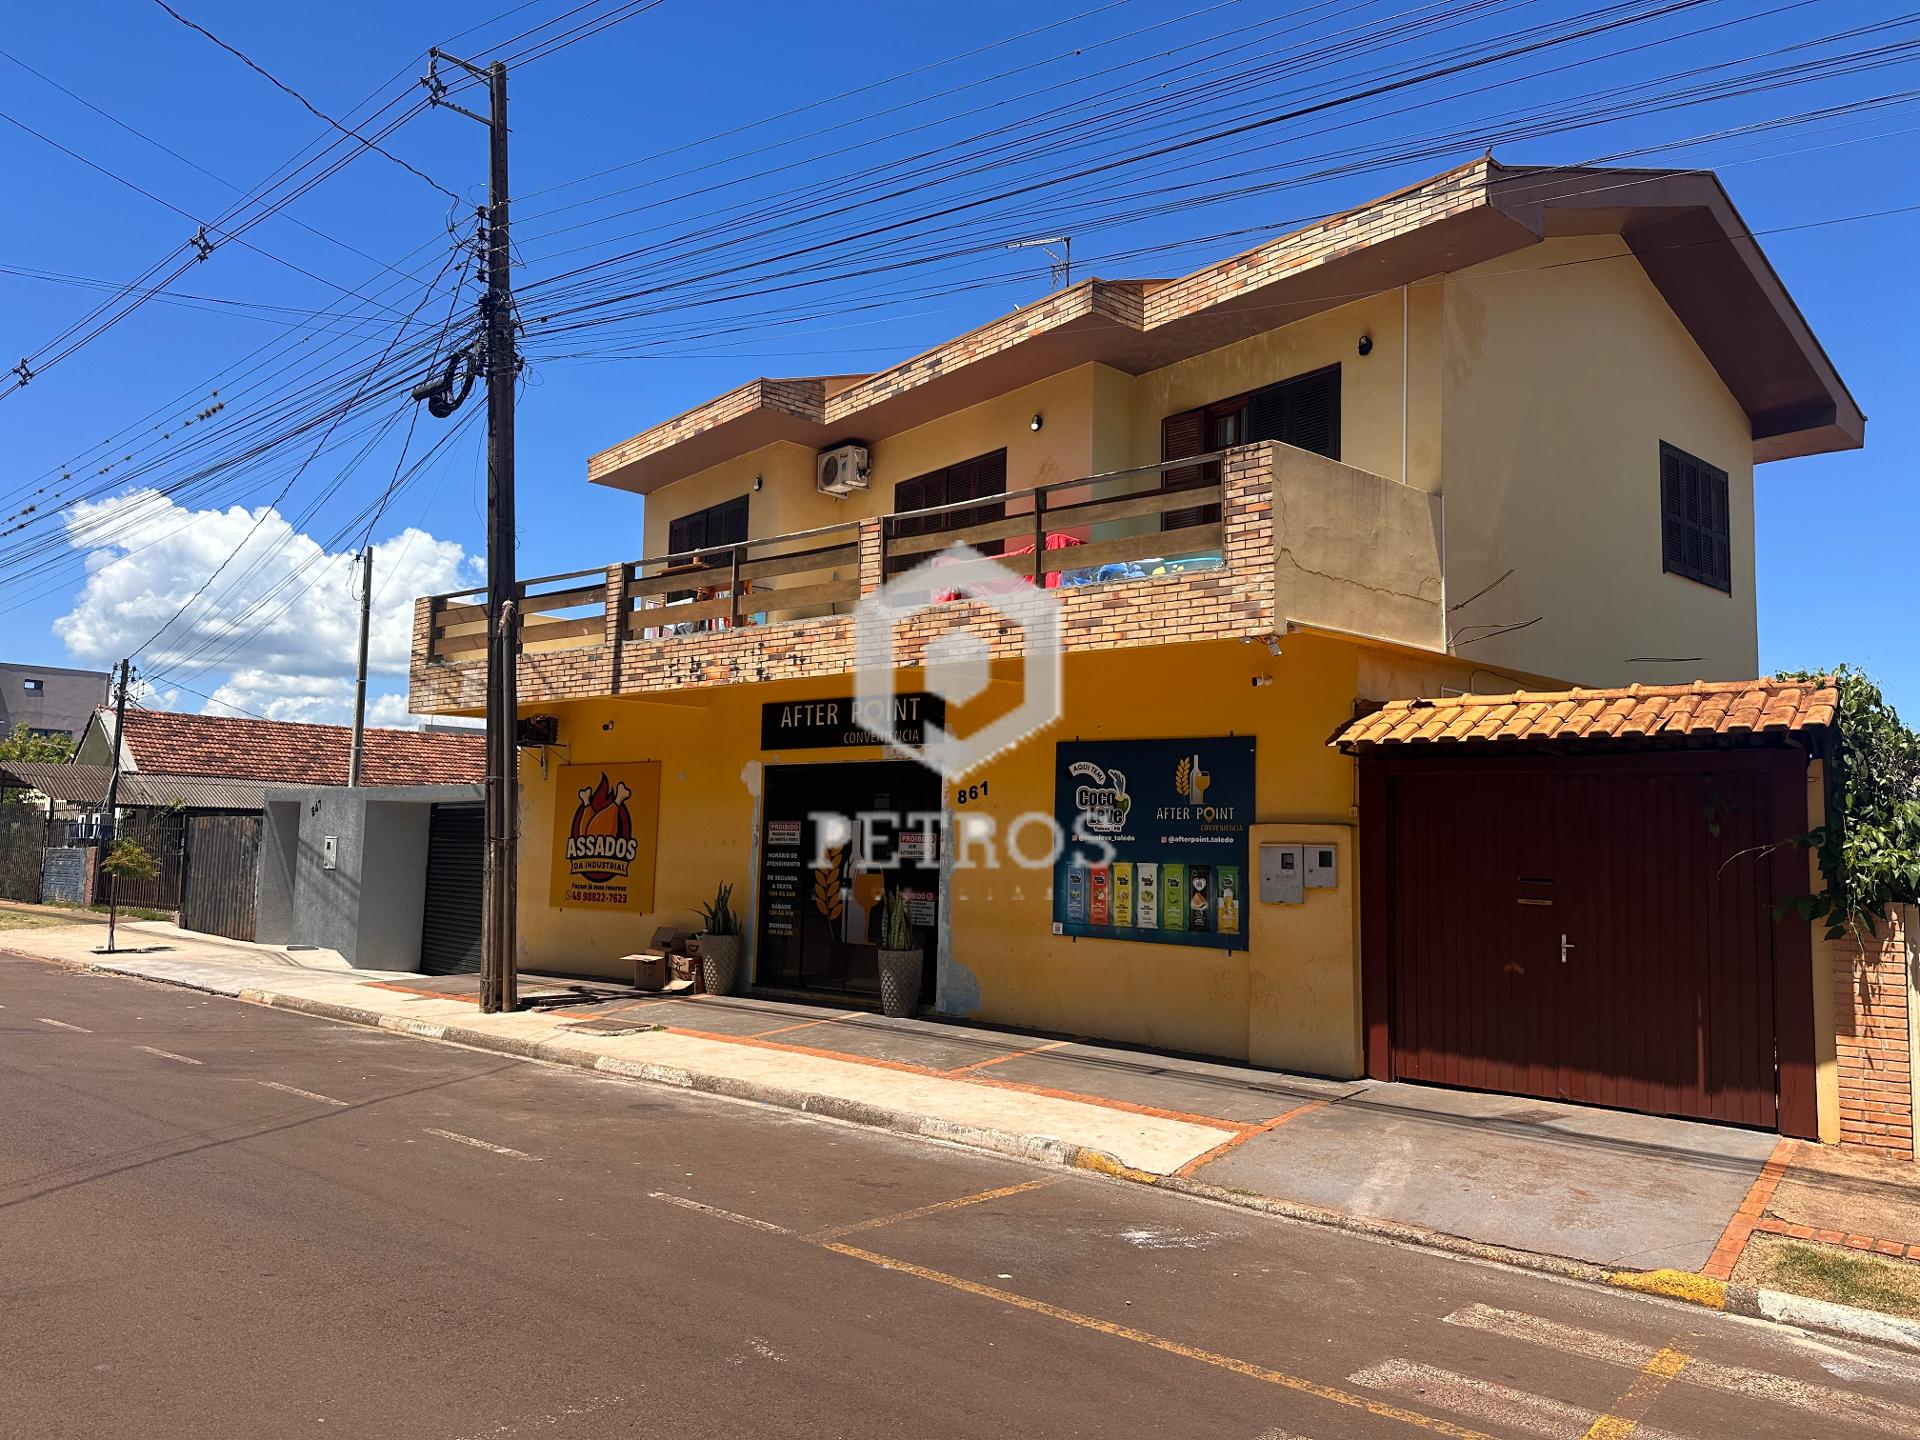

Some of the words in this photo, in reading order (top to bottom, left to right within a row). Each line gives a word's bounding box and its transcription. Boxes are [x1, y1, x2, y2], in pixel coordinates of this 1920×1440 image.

[781, 704, 838, 728] AFTER
[851, 697, 921, 726] POINT
[1073, 764, 1090, 772] AQUI
[957, 780, 989, 805] 861
[1079, 789, 1116, 806] Coco
[1091, 806, 1123, 824] Leve
[1156, 807, 1190, 820] AFTER
[1196, 806, 1235, 823] POINT
[566, 835, 637, 860] ASSADOS
[1168, 836, 1235, 844] @afterpoint.toledo
[584, 861, 626, 872] INDUSTRIAL
[572, 892, 582, 900] 45
